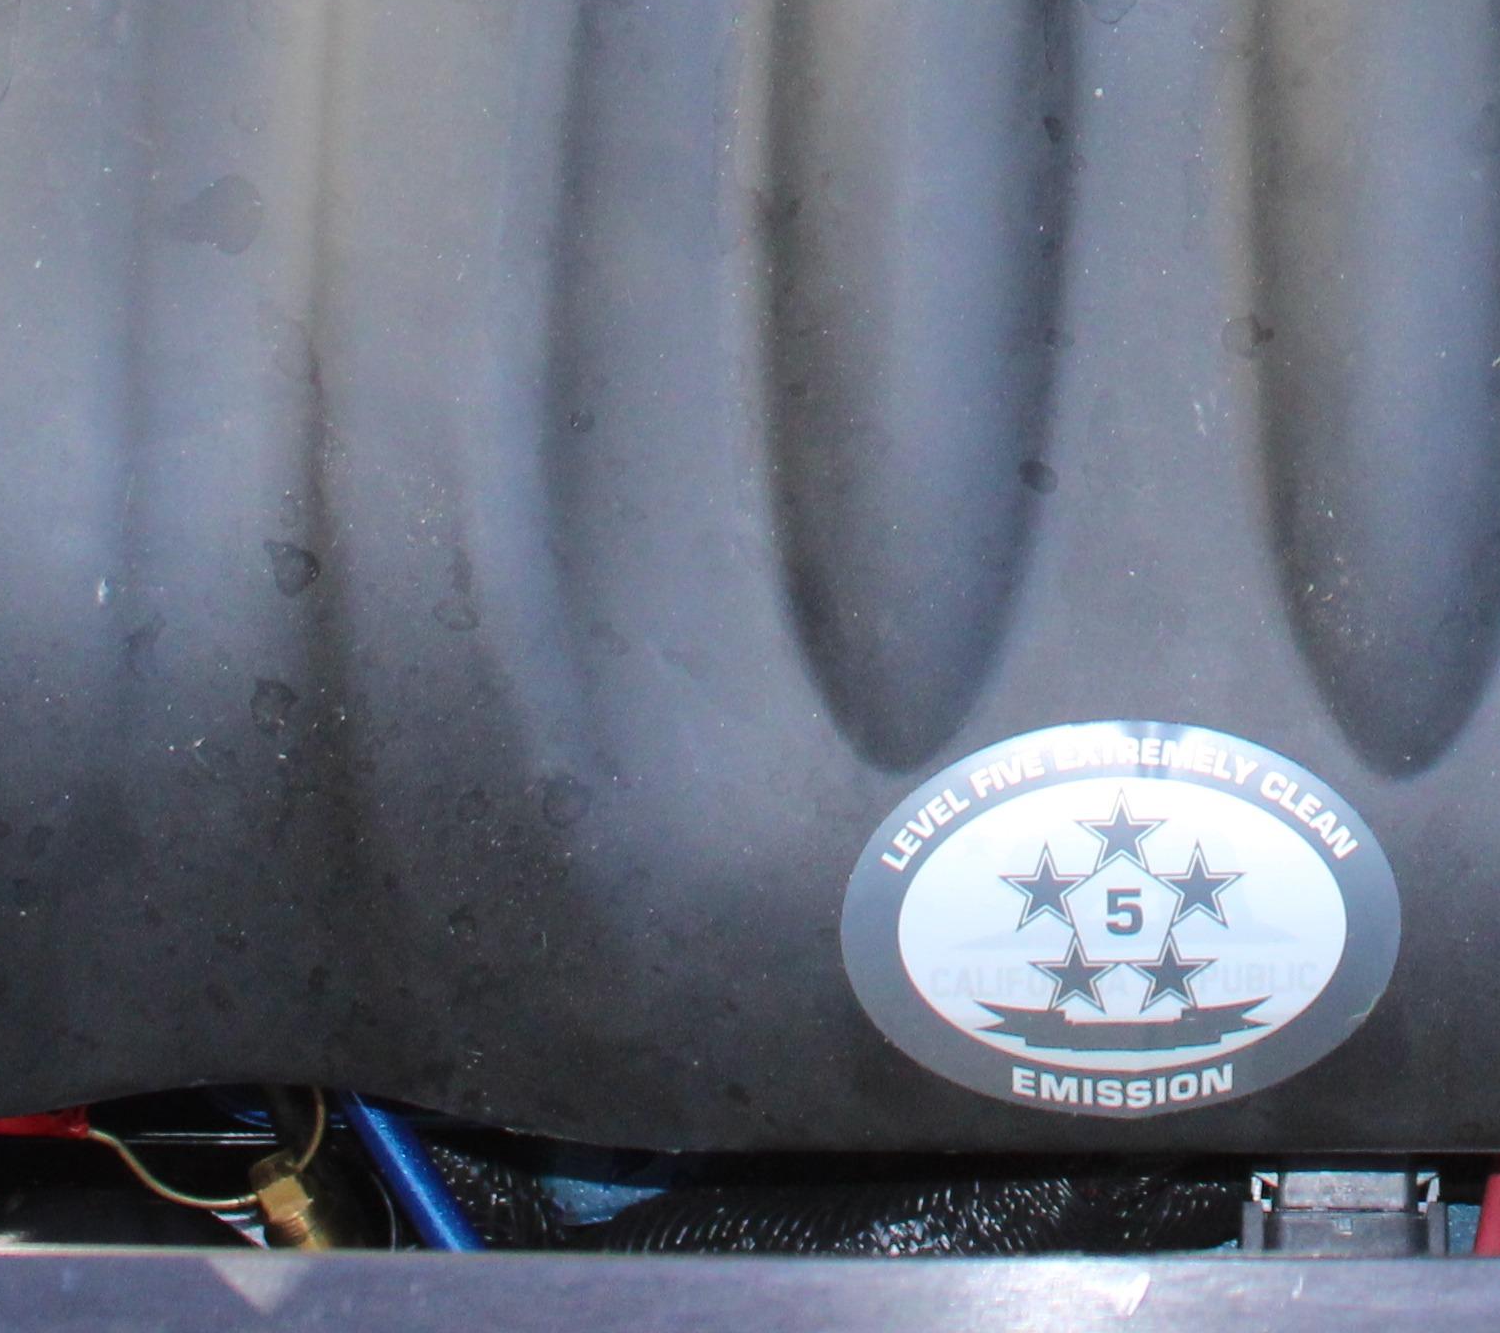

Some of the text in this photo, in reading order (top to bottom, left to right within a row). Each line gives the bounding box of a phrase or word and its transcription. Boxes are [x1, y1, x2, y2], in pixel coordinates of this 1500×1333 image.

[881, 735, 1360, 874] LEVEL FIVE EXTREMELY CLEAN
[1104, 887, 1145, 937] 5
[930, 966, 1128, 998] CALIFOA
[1011, 1062, 1235, 1108] EMISSION
